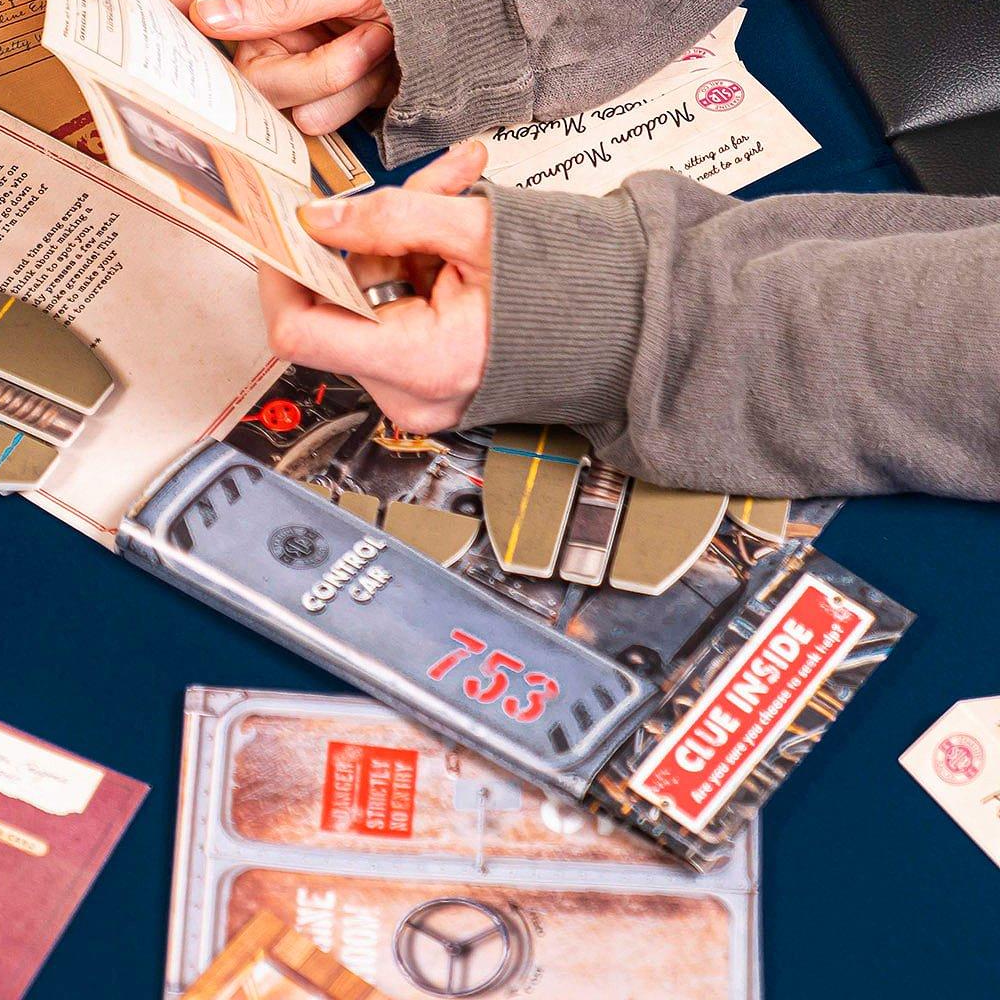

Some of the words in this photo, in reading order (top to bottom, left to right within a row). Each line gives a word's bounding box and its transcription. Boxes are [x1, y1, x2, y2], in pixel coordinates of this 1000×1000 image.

[708, 88, 732, 103] SLR
[610, 101, 694, 144] Madam
[5, 163, 18, 176] on
[516, 141, 611, 188] Madman
[684, 151, 716, 170] sitting
[718, 144, 729, 153] as
[730, 135, 749, 149] far
[696, 165, 719, 181] next
[720, 161, 731, 170] to
[743, 141, 763, 161] girl
[0, 205, 13, 219] go
[9, 182, 32, 207] down
[9, 169, 27, 189] who
[1, 215, 18, 233] I'm
[14, 193, 38, 219] tired
[35, 182, 48, 196] of
[11, 256, 29, 275] and
[26, 240, 43, 259] the
[41, 220, 63, 245] gang
[59, 190, 90, 224] erupts
[9, 267, 36, 296] think
[32, 243, 57, 271] about
[55, 212, 87, 246] making
[84, 205, 92, 214] a
[19, 271, 48, 303] ertain
[45, 259, 59, 274] to
[54, 240, 78, 265] spot
[74, 221, 95, 244] you,
[44, 257, 77, 294] presses
[74, 251, 83, 261] a
[79, 235, 97, 253] few
[94, 210, 119, 238] metal
[96, 228, 119, 253] This
[65, 291, 79, 305] to
[75, 267, 100, 294] make
[95, 247, 119, 272] your
[71, 300, 86, 316] to
[81, 259, 124, 306] correctly
[301, 535, 388, 613] CONTROL
[349, 565, 392, 603] CAR
[426, 627, 559, 722] 753
[674, 704, 740, 772] CLUE
[725, 617, 814, 714] INSIDE
[690, 781, 711, 804] Are
[709, 760, 732, 786] you
[727, 739, 747, 763] sure
[745, 720, 768, 745] you
[758, 688, 792, 727] choose
[787, 674, 802, 689] to
[797, 650, 822, 678] seek
